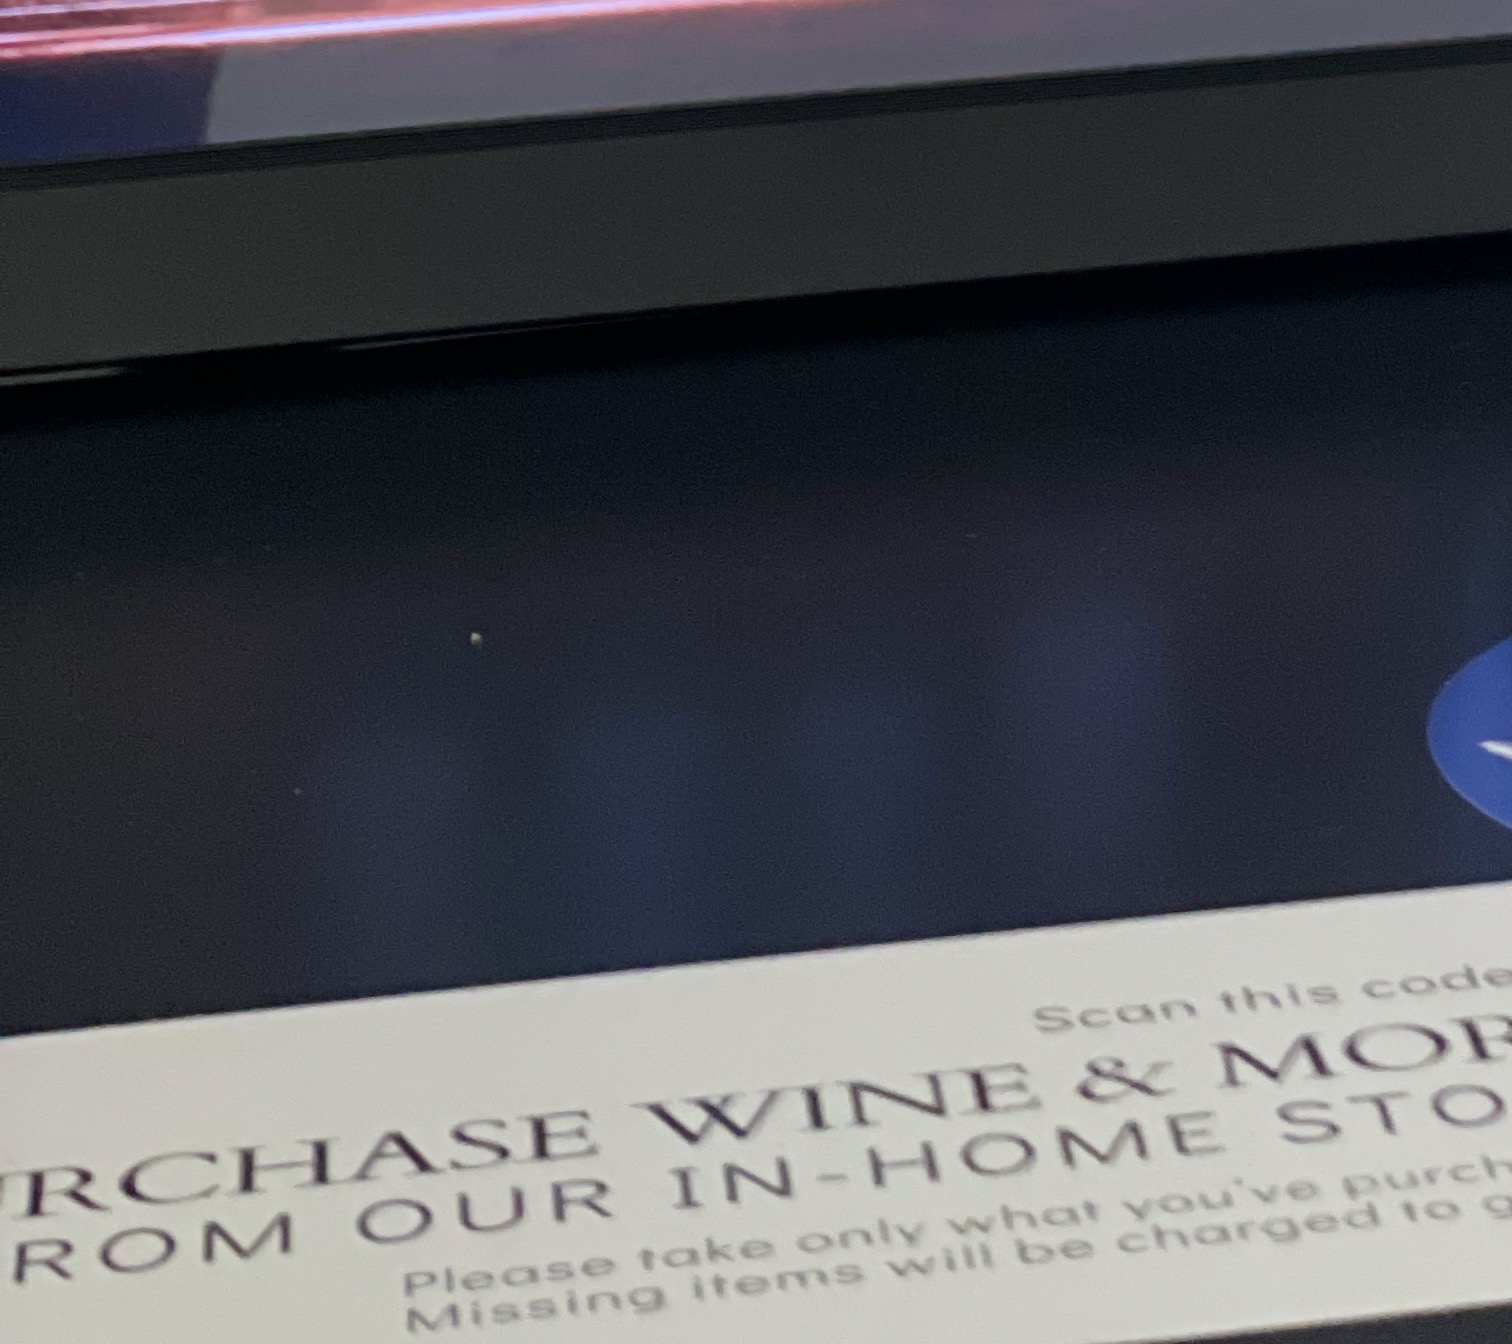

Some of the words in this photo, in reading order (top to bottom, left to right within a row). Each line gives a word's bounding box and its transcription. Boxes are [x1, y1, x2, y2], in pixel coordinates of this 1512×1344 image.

[1034, 995, 1198, 1033] Scan
[1219, 981, 1340, 1013] this
[0, 1109, 601, 1220] RCHASE
[631, 1062, 1042, 1149] WINE
[1076, 1055, 1176, 1104] &
[355, 1178, 615, 1245] OUR
[671, 1111, 1226, 1210] IN-HOME
[403, 1254, 616, 1298] Please
[638, 1239, 775, 1273] take
[796, 1201, 926, 1254] only
[943, 1200, 1101, 1239] what
[1123, 1176, 1321, 1223] you've
[404, 1281, 668, 1336] Missing
[691, 1261, 866, 1302] items
[884, 1241, 995, 1281] will
[1017, 1235, 1095, 1267] be
[1116, 1204, 1382, 1257] charged
[1402, 1194, 1461, 1222] to
